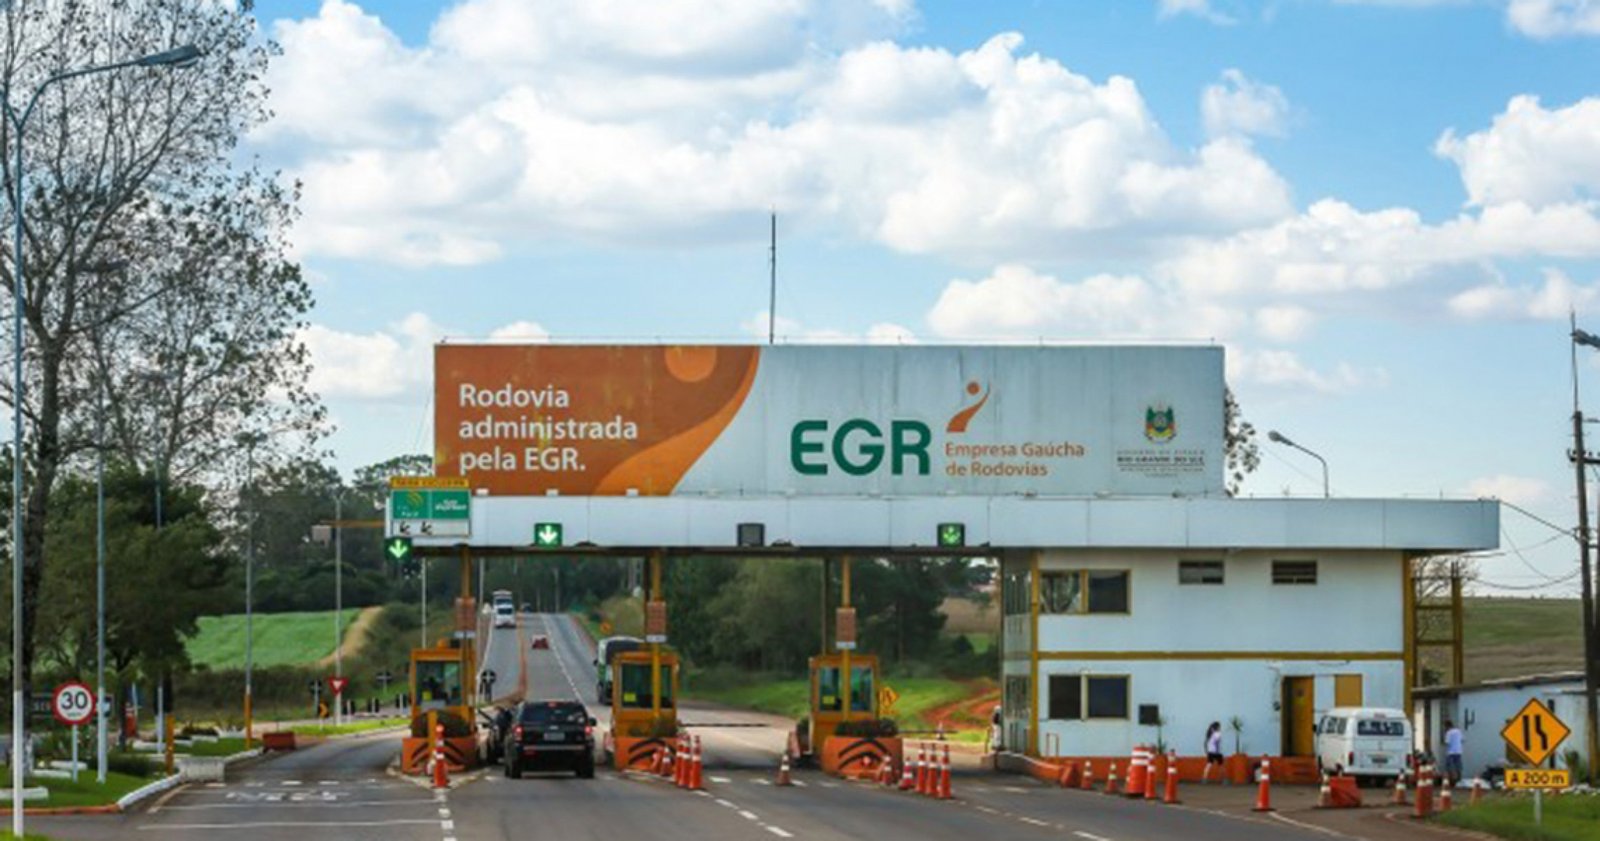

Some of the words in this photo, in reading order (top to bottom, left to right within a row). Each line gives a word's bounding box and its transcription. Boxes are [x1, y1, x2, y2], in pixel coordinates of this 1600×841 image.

[459, 383, 570, 408] Rodovia
[459, 414, 638, 440] administrada
[790, 418, 932, 476] EGR
[945, 442, 1018, 460] Empresa
[1023, 441, 1085, 457] Gaúcha
[459, 446, 517, 476] pela
[524, 447, 586, 471] EGR.
[945, 461, 967, 477] de
[971, 460, 1048, 477] Rodovias
[61, 691, 88, 710] 30
[1511, 771, 1519, 784] A
[1523, 771, 1550, 785] 200
[1552, 774, 1565, 784] m
